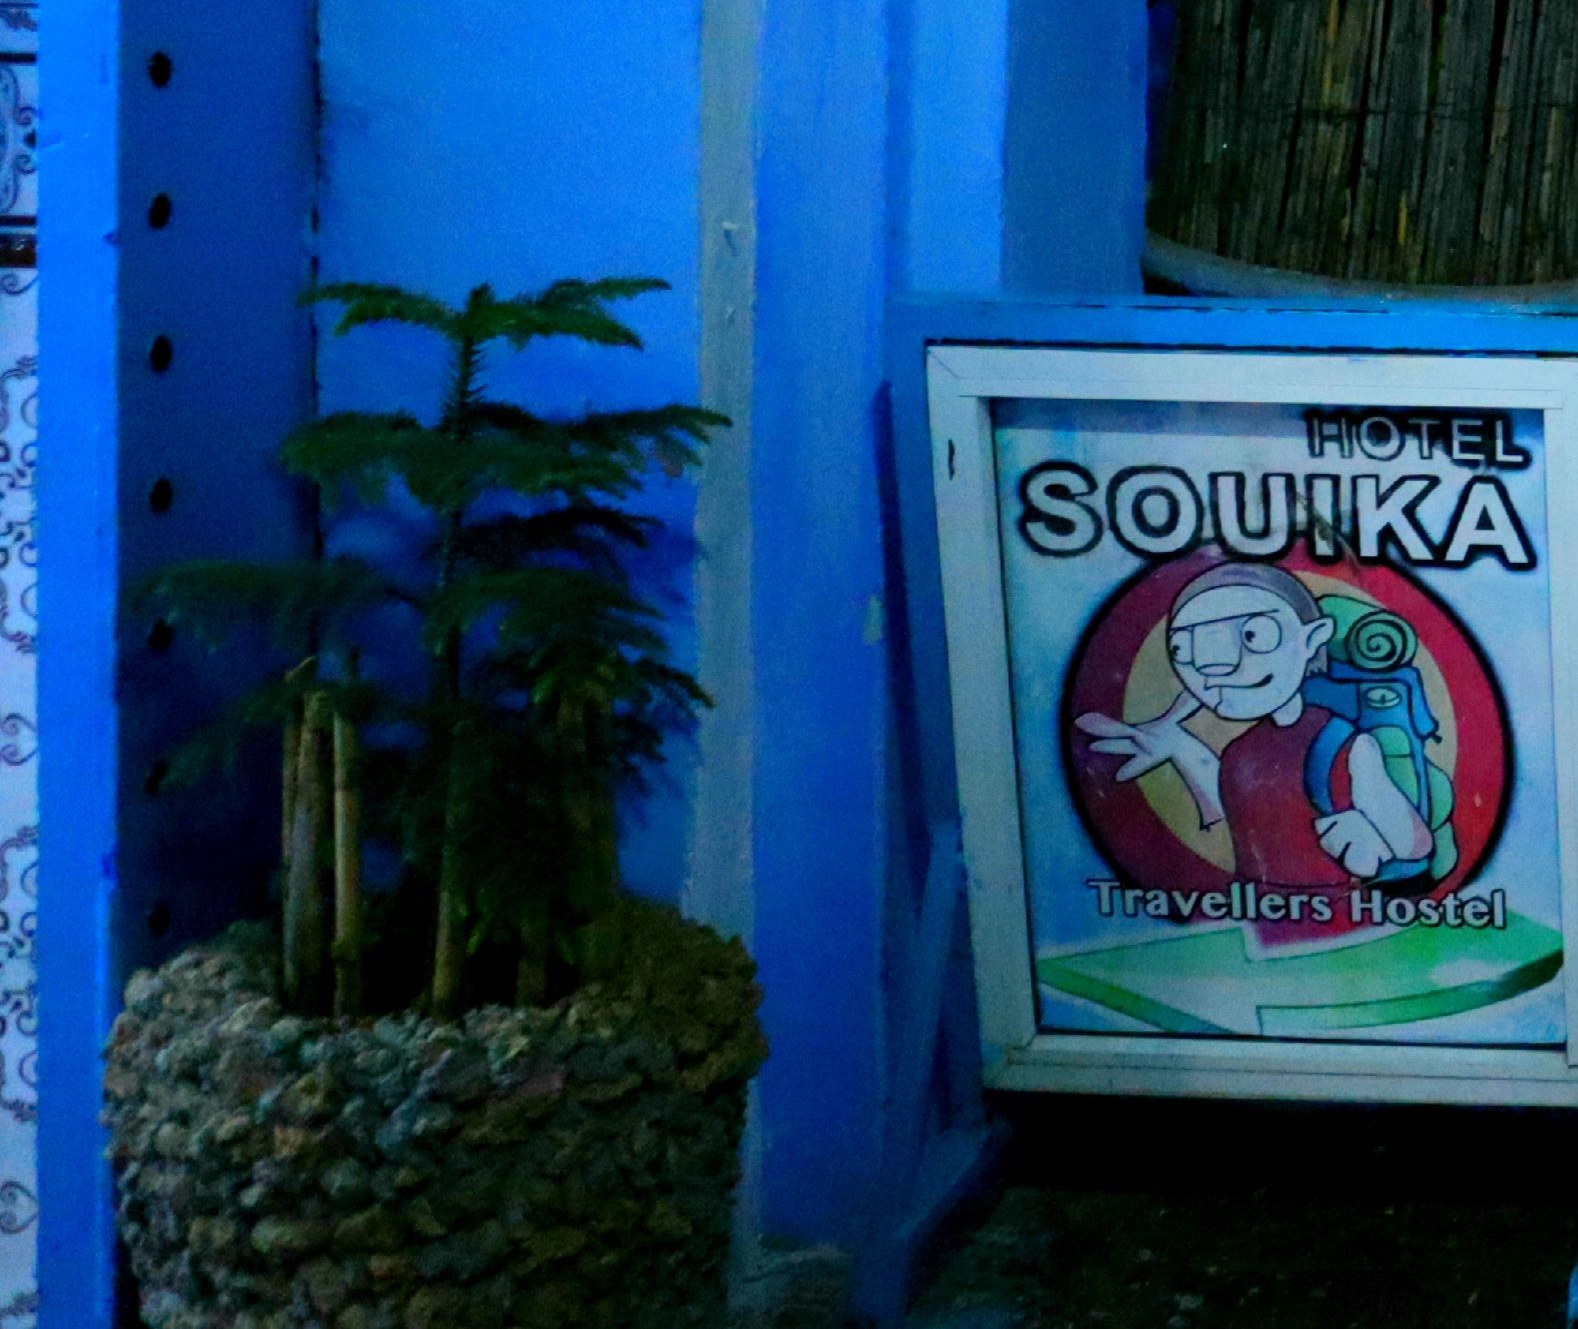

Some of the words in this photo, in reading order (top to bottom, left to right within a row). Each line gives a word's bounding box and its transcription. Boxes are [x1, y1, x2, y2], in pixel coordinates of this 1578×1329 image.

[1306, 411, 1531, 469] HOTEL
[1018, 463, 1537, 569] SOUIKA
[1088, 878, 1333, 924] Travellers
[1350, 890, 1507, 929] Hostel
